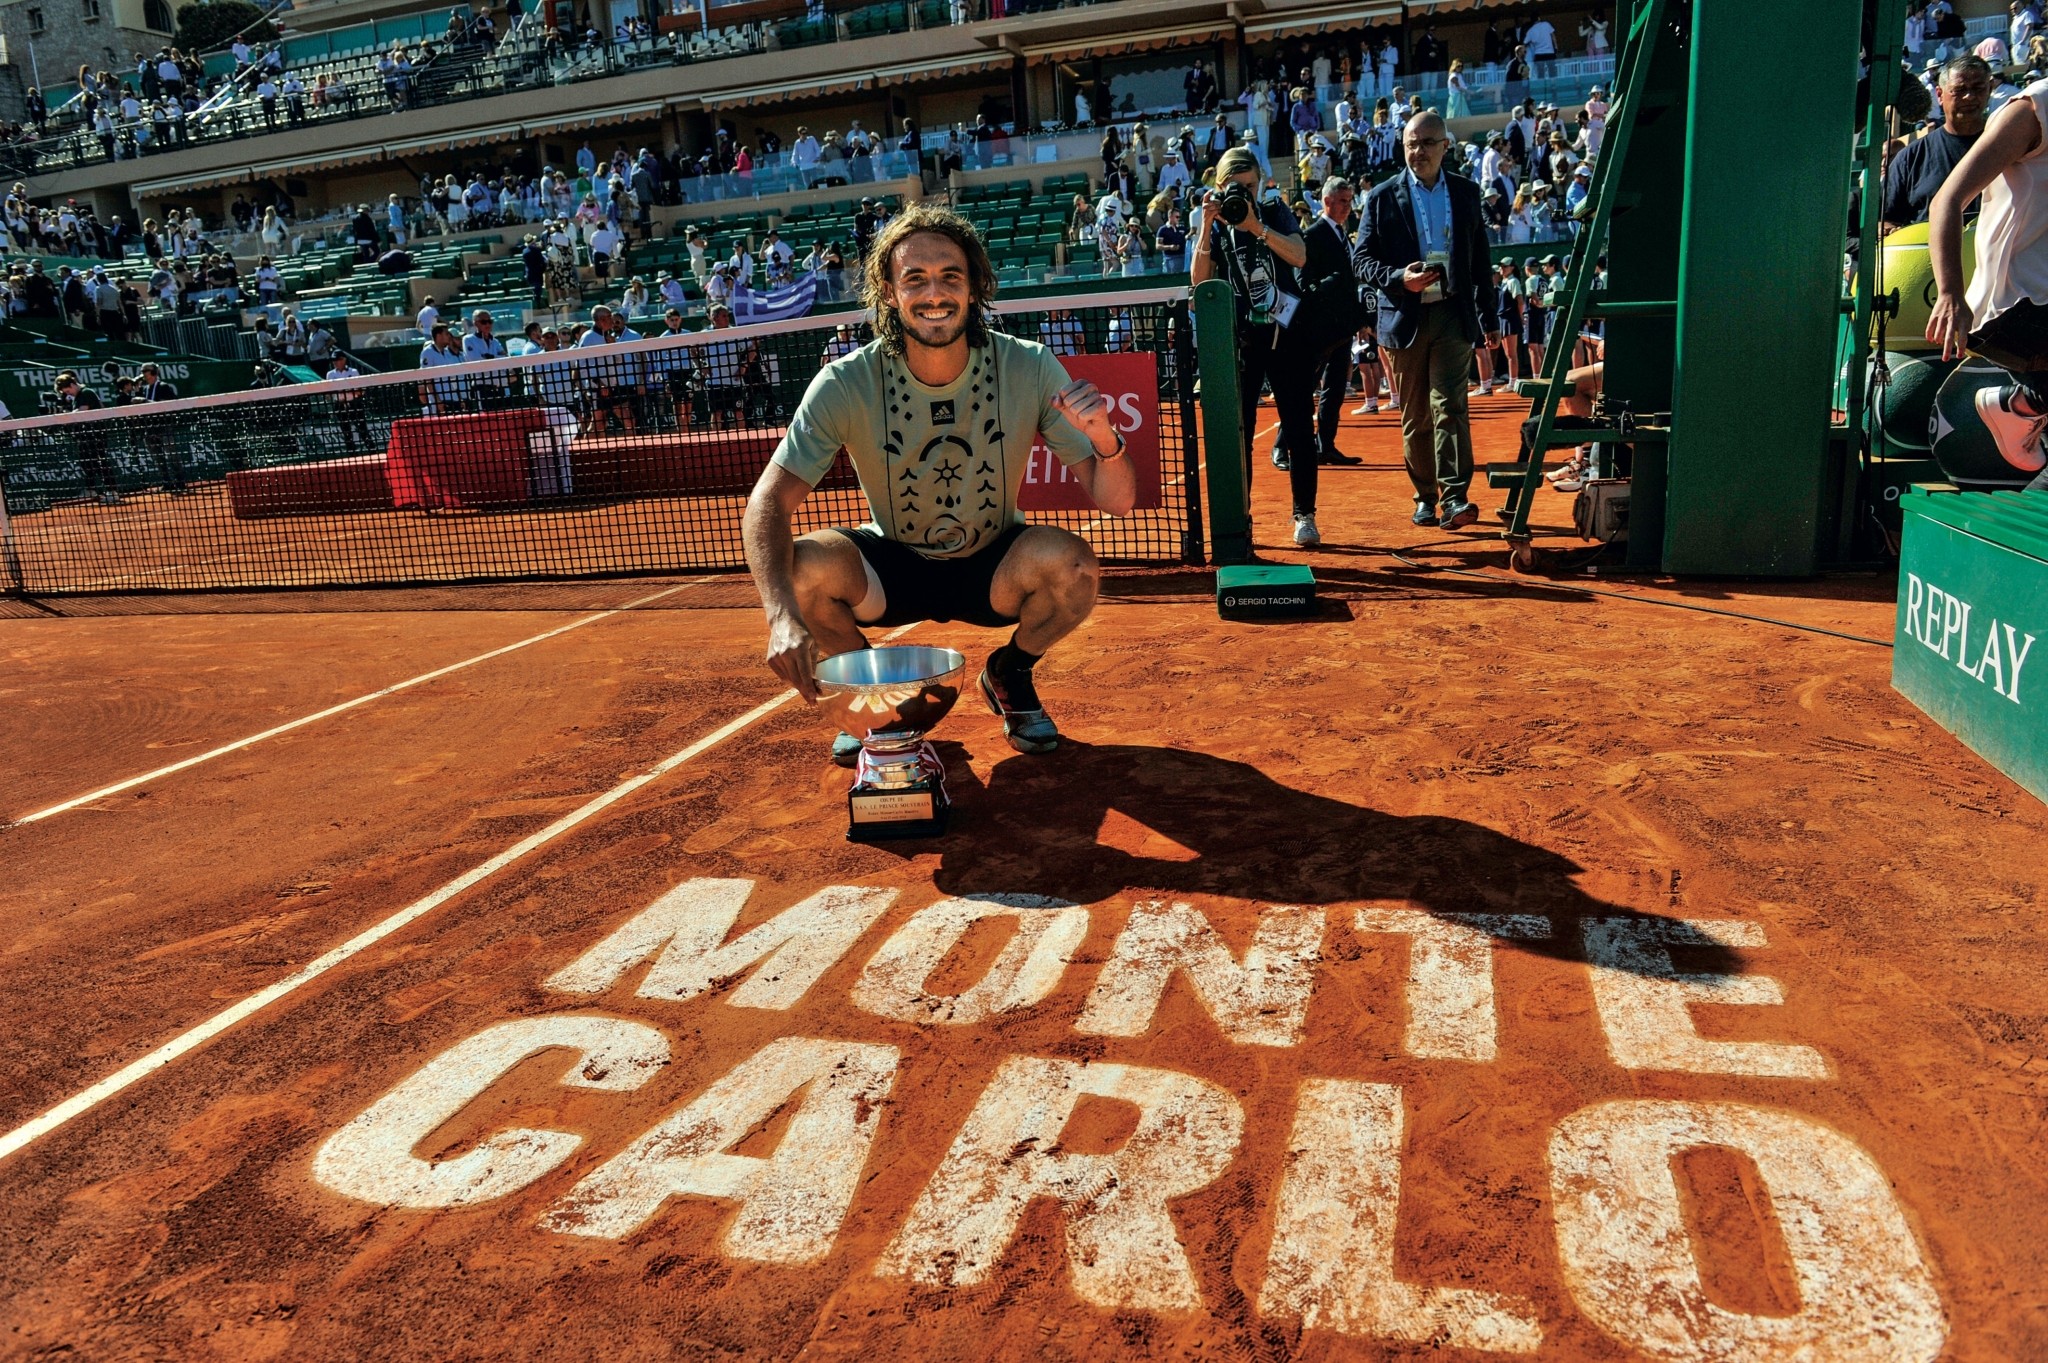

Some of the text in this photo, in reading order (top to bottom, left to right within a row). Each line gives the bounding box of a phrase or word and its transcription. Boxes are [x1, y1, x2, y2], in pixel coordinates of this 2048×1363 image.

[14, 364, 190, 387] THEMES MINS
[933, 413, 954, 421] adidas
[1904, 572, 2036, 705] REPLAY
[543, 876, 1829, 1080] MONTE
[311, 1015, 1951, 1363] CARLO
